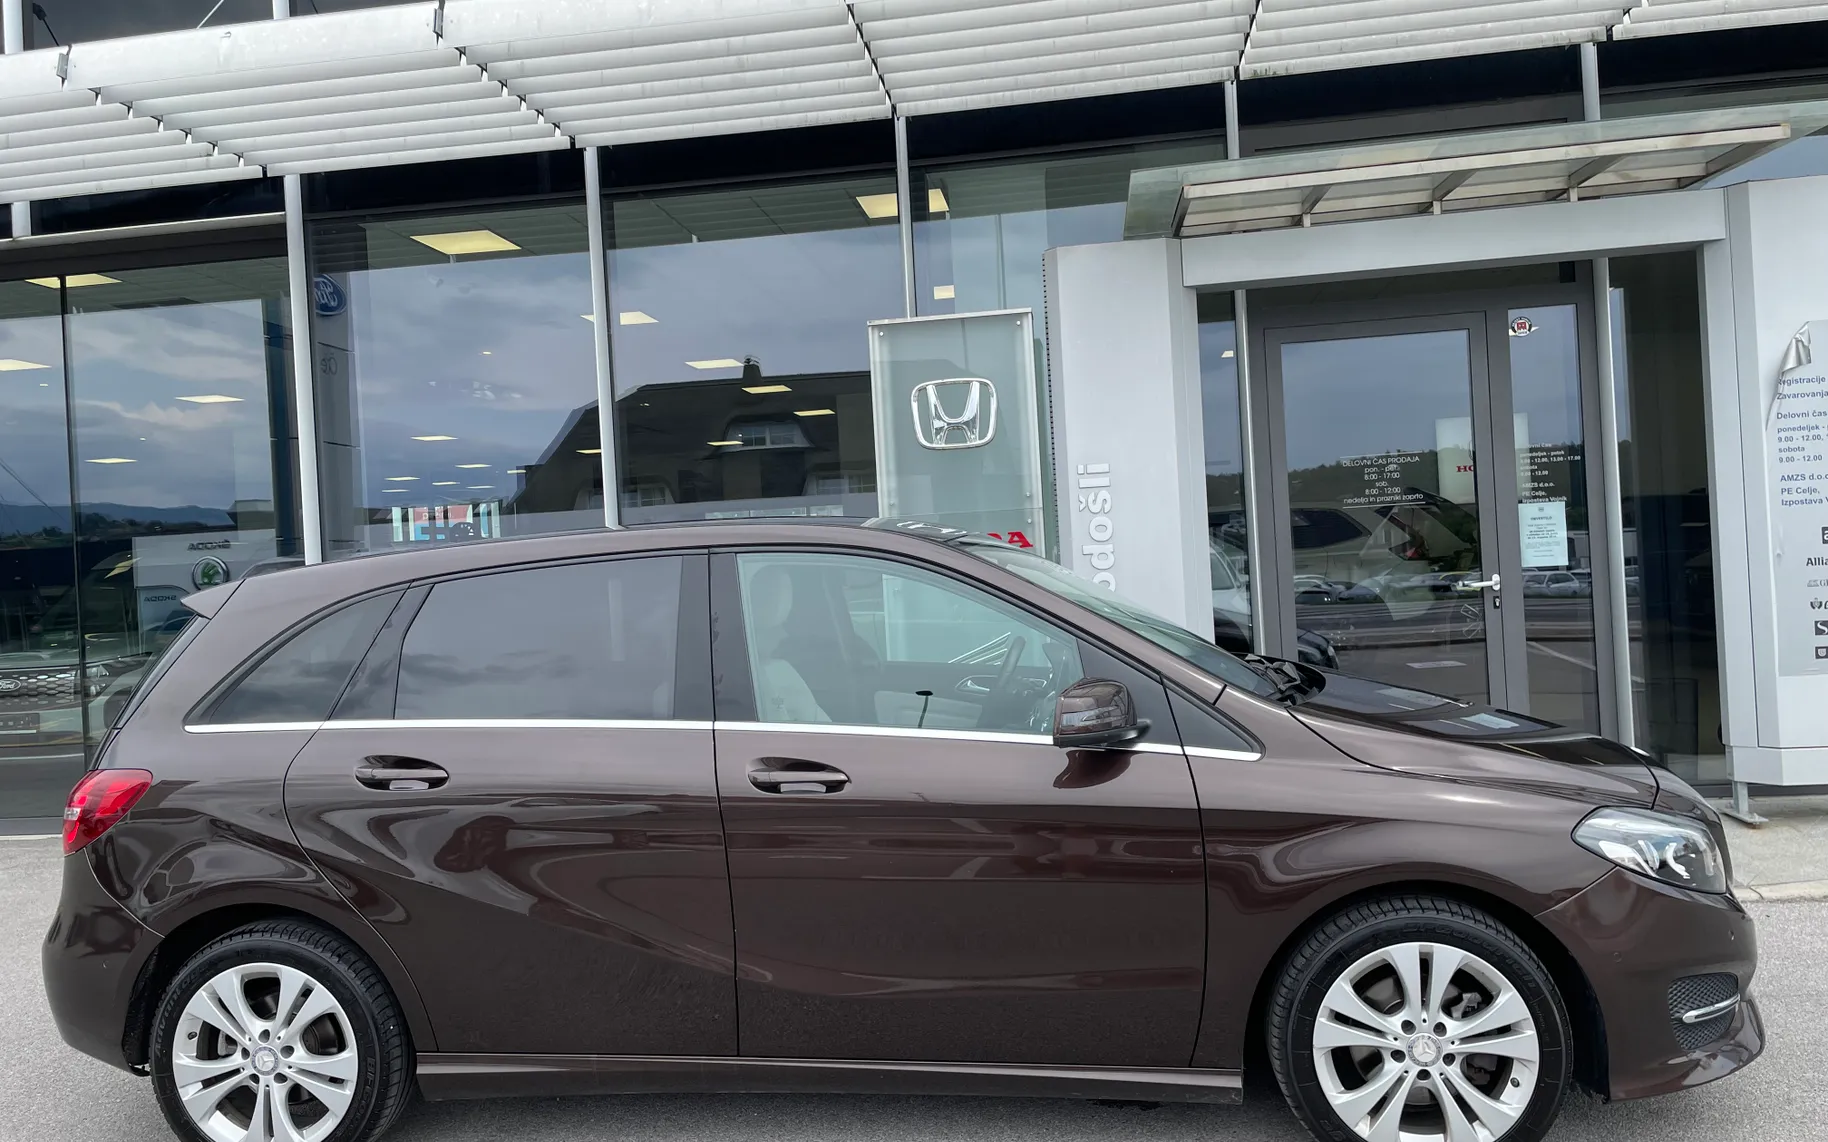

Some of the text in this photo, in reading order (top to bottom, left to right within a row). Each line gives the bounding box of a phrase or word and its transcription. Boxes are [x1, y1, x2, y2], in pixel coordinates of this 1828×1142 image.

[1776, 409, 1827, 420] Delovni čas
[1777, 424, 1820, 434] ponedeljek
[1801, 434, 1824, 442] 12.00,
[1342, 456, 1420, 467] DELOVNI ČAS PRODAJA
[1780, 473, 1806, 482] AMZS
[1781, 486, 1820, 495] PE Celje,
[1343, 496, 1369, 504] nedelja
[1376, 494, 1401, 503] prazniki
[1402, 493, 1424, 501] zaprto
[1781, 498, 1823, 507] Izpostava
[987, 531, 1034, 549] A
